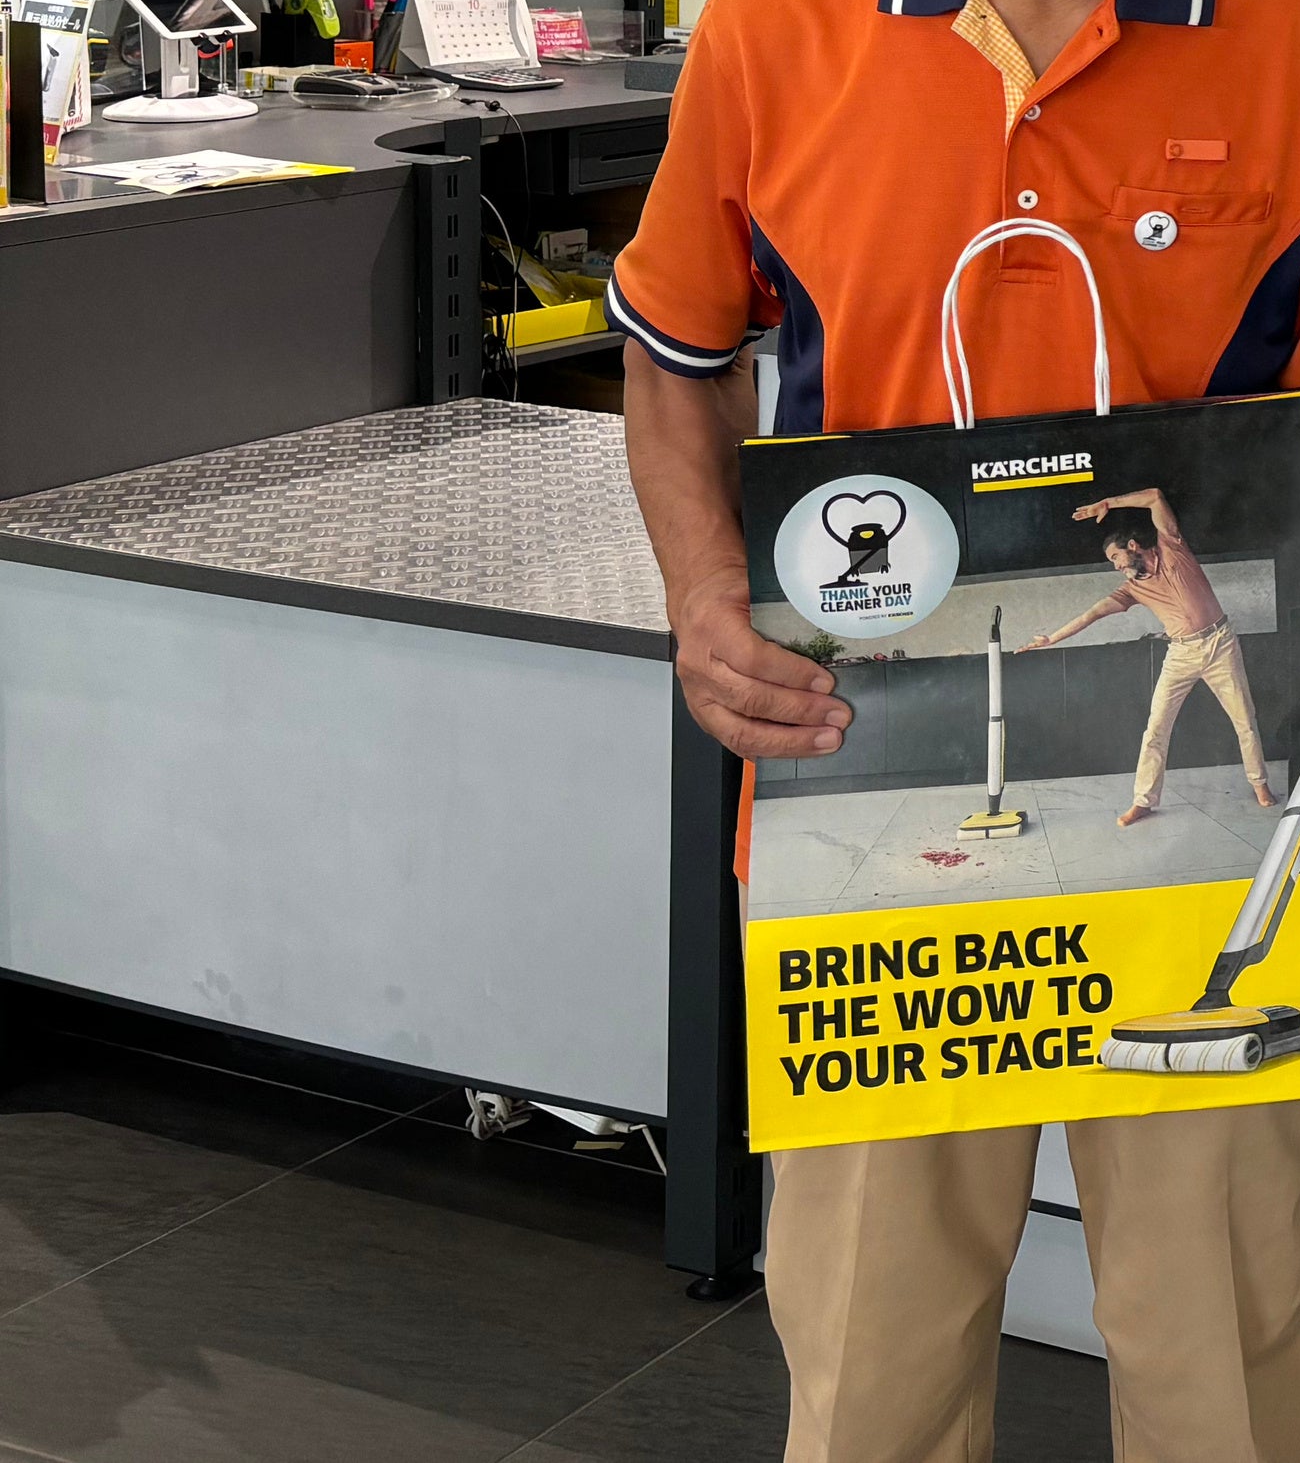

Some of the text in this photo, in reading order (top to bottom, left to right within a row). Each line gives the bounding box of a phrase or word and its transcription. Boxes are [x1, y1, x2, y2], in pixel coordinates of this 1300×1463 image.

[468, 0, 479, 10] 10
[971, 452, 1092, 481] KÄRCHER
[820, 583, 912, 601] THANK YOUR
[821, 594, 912, 612] CLEANER DAY
[779, 924, 1089, 992] BRING BACK
[778, 973, 1113, 1044] THE WOW TO
[780, 1045, 926, 1096] YOUR
